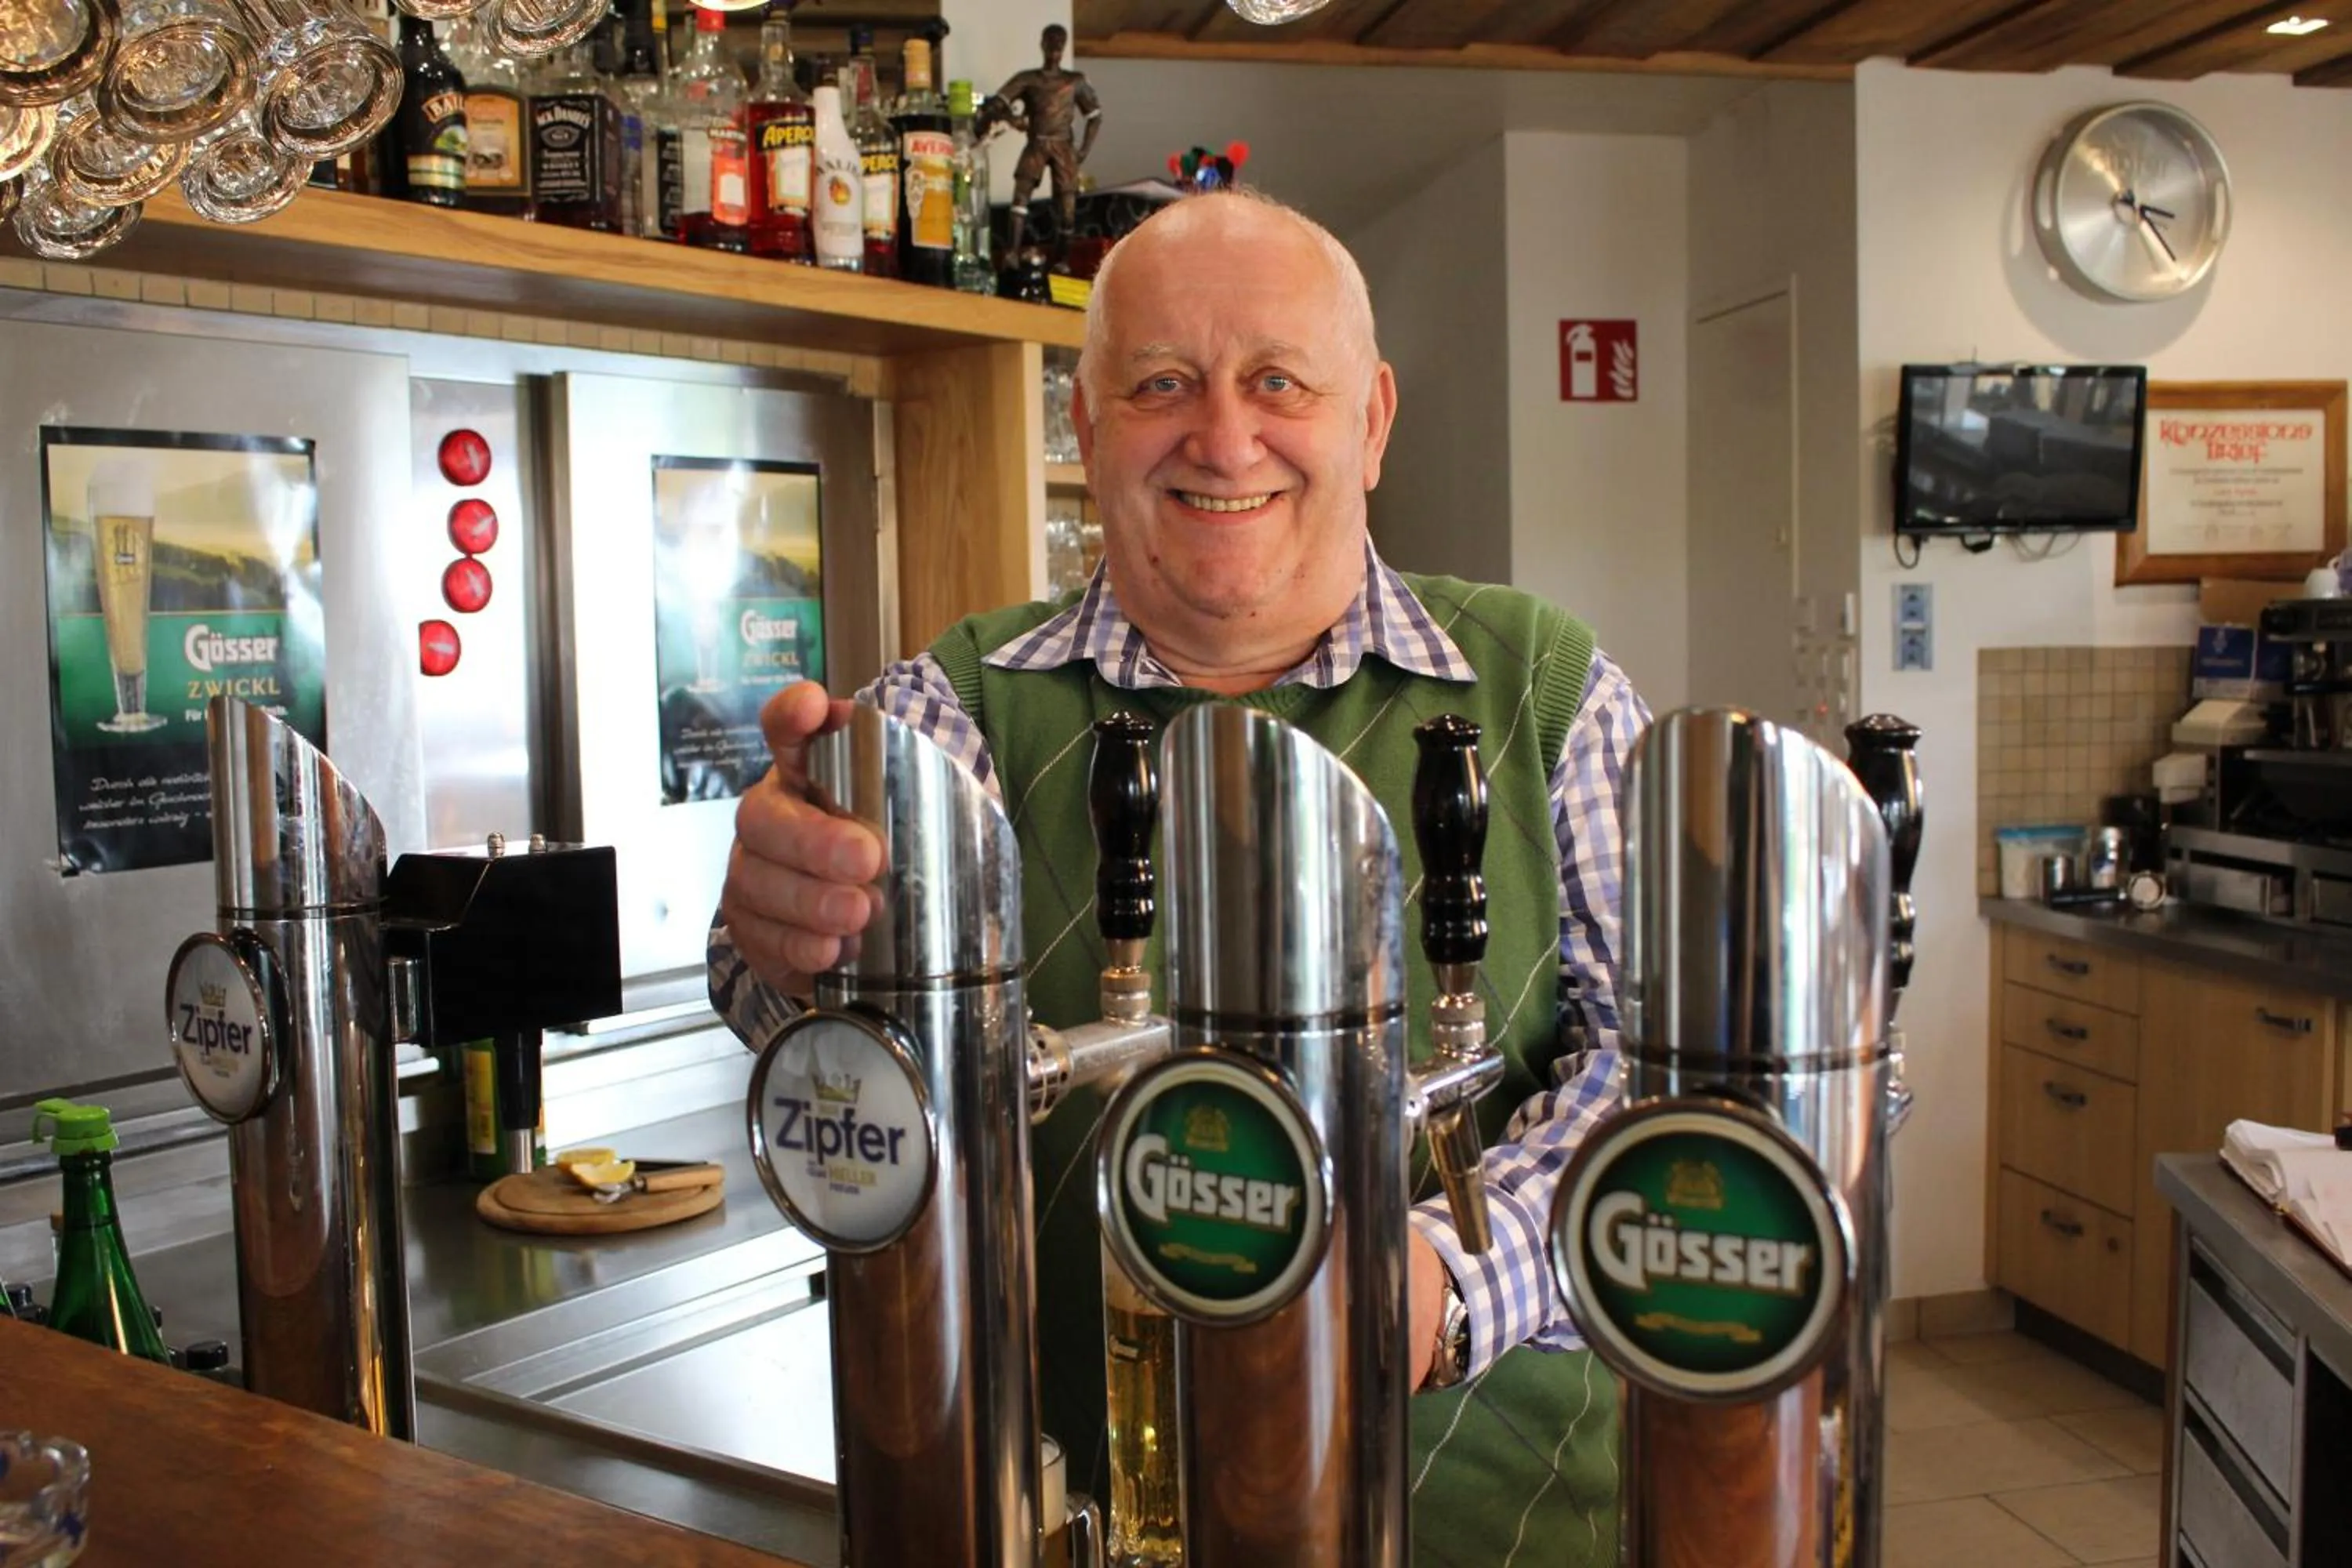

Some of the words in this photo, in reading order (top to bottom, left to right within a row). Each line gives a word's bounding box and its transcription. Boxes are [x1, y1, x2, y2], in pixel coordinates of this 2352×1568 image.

[184, 624, 278, 673] Gösser
[187, 677, 281, 699] ZWICKL
[180, 1003, 252, 1055] Zipfer
[774, 1098, 906, 1166] Zipfer
[1126, 1134, 1301, 1223] Gösser
[1590, 1190, 1813, 1291] Gösser
